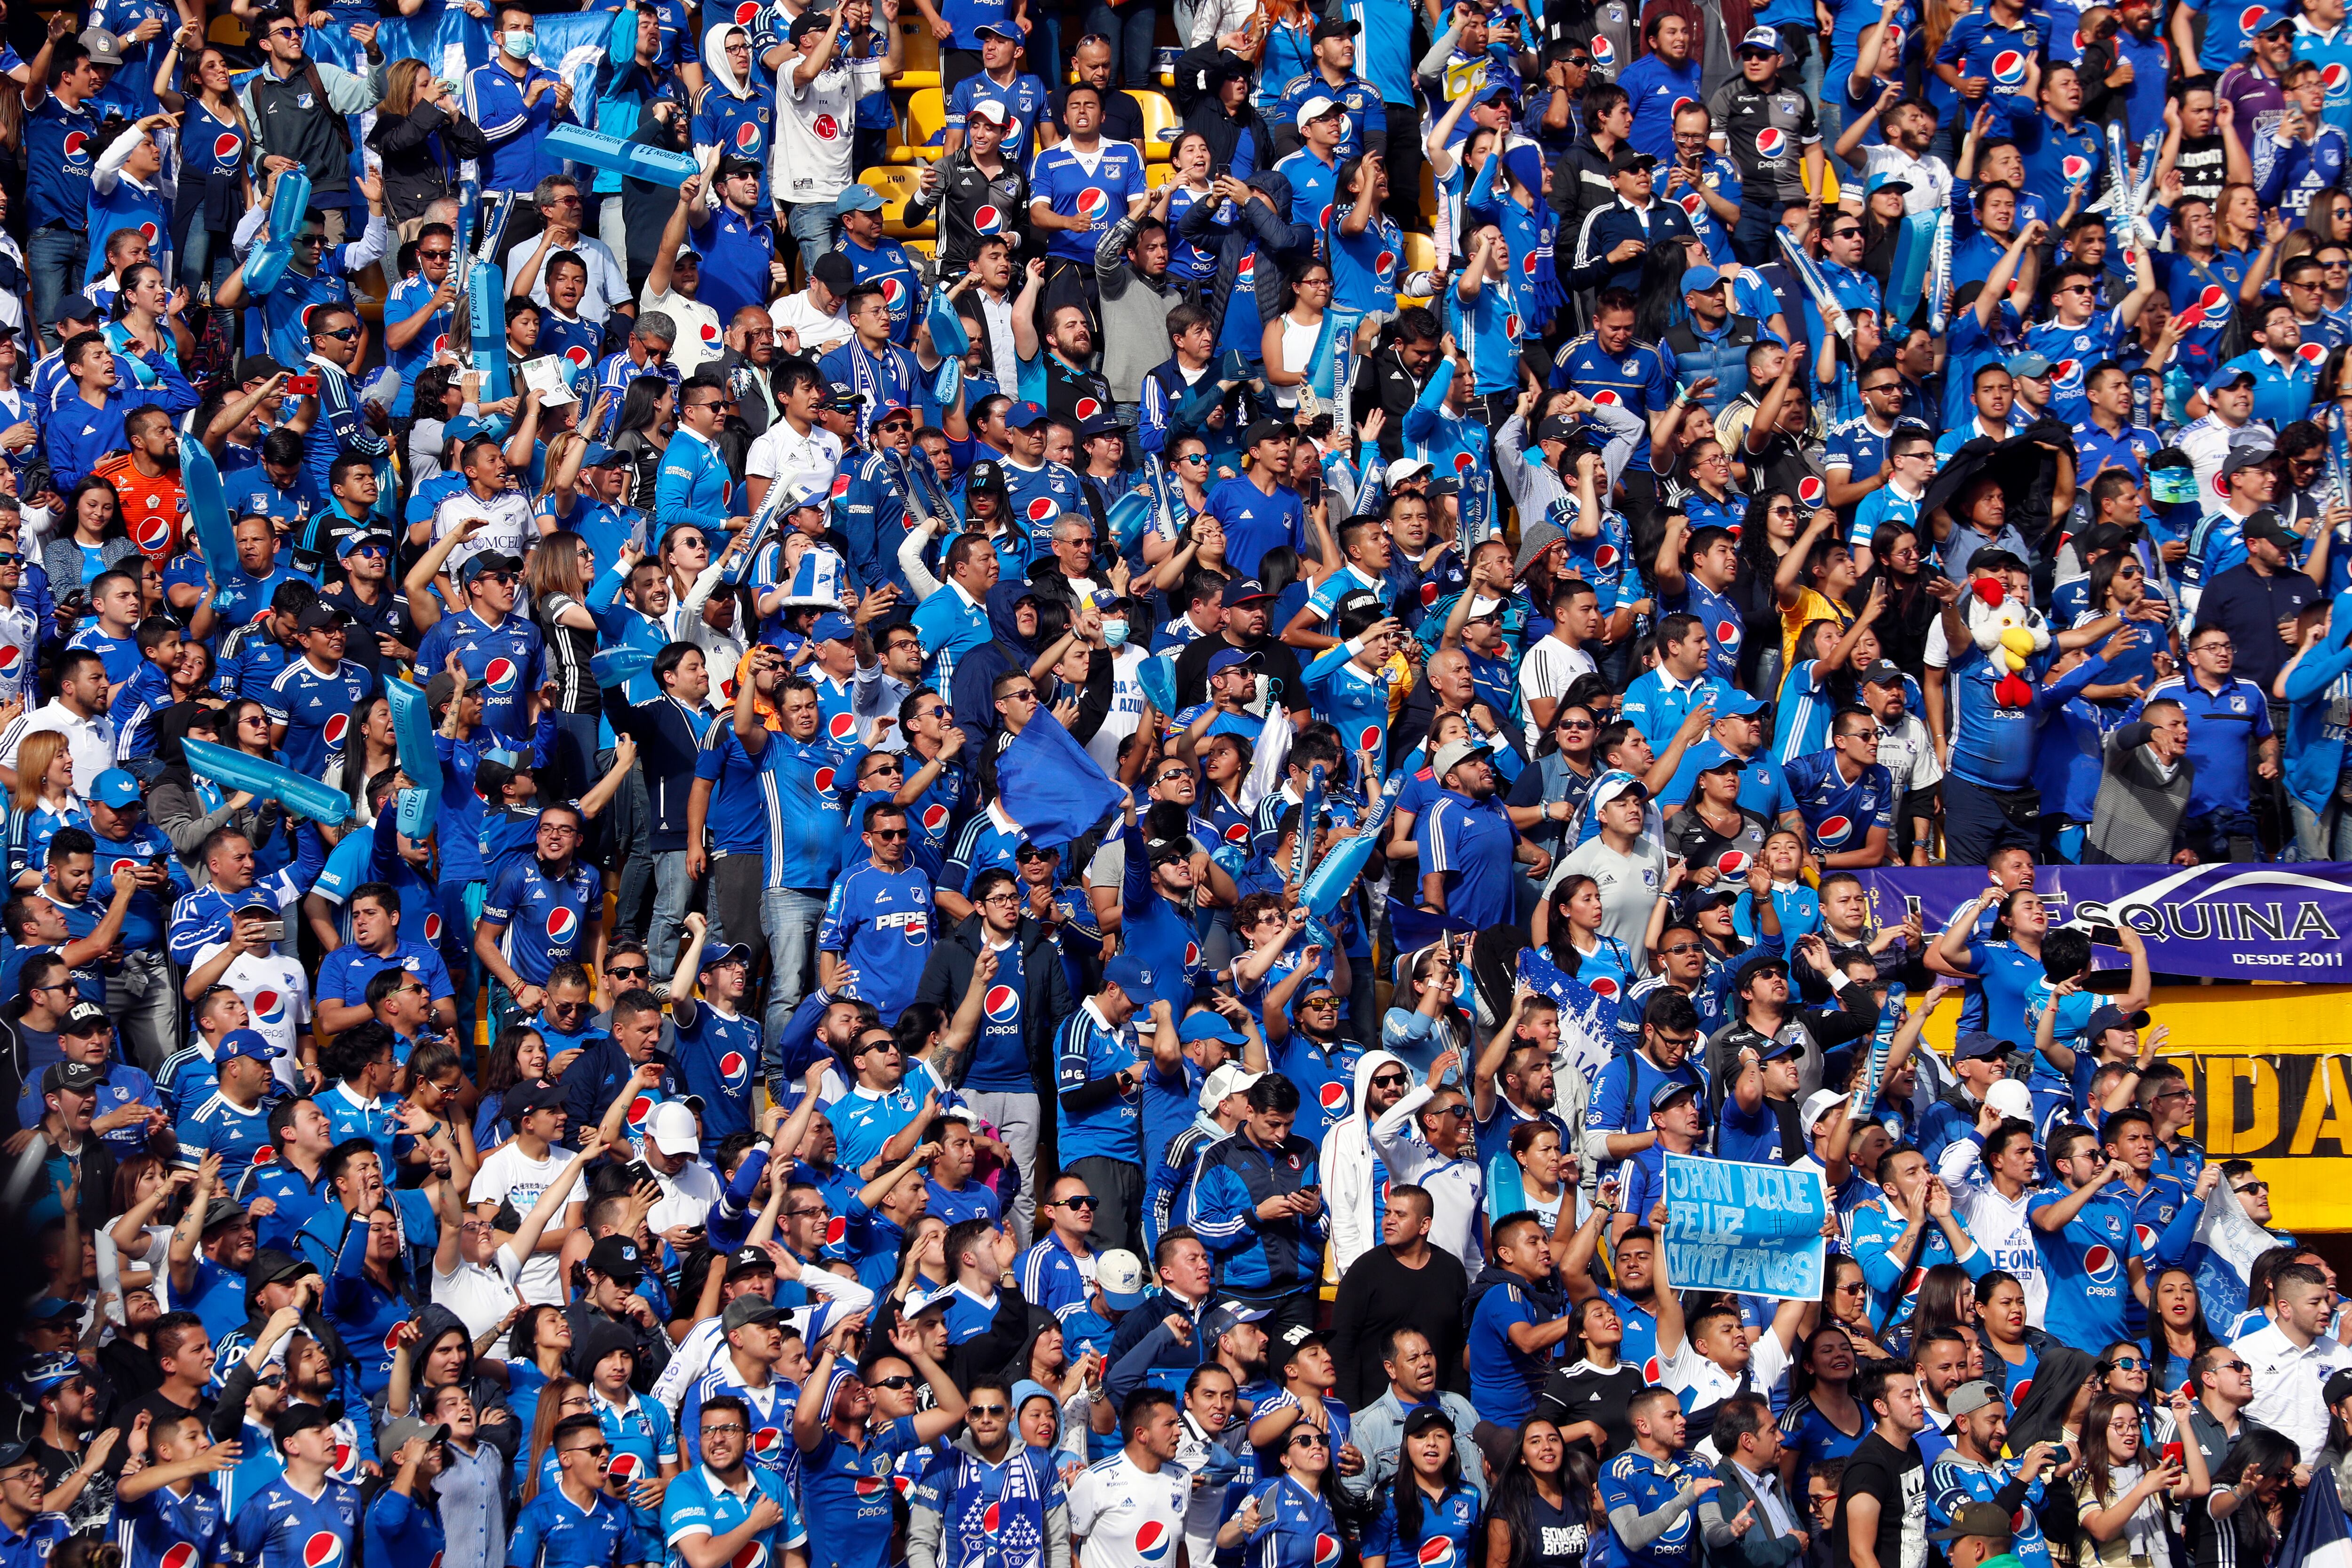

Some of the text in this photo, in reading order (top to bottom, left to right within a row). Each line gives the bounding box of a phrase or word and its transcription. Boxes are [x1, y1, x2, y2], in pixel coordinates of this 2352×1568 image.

[756, 39, 766, 48] LG
[564, 126, 595, 138] FUERON
[595, 134, 624, 145] NUNCA
[638, 145, 685, 162] FUERON 11
[1333, 145, 1350, 154] epsi
[1049, 159, 1076, 168] HYUNDAI
[1757, 159, 1786, 169] pepsi
[63, 166, 89, 177] pepsi
[1089, 221, 1108, 232] epsi
[890, 311, 907, 322] epsi
[2055, 389, 2086, 401] pepsi
[335, 428, 349, 436] LG
[1348, 594, 1377, 611] CAMPEONES
[488, 696, 513, 706] pepsi
[393, 698, 405, 734] RIVALO
[1994, 710, 2025, 719] pepsi
[1878, 758, 1908, 767] ERVEZA
[403, 788, 417, 817] VALO
[1316, 844, 1342, 874] FUERON
[322, 871, 342, 881] BALIFE
[875, 912, 929, 931] PEPS
[547, 947, 572, 958] pepsi
[2233, 953, 2343, 967] DESDE 2011
[985, 1025, 1017, 1036] pepsi
[1061, 1069, 1085, 1080] LG G2
[1668, 1159, 1733, 1204] JHON
[1666, 1201, 1745, 1246] FELIZ
[1769, 1215, 1814, 1238] #22
[2087, 1286, 2116, 1297] pepsi
[963, 1326, 983, 1336] adidas
[858, 1507, 888, 1519] pepsi
[1946, 1502, 1958, 1518] LG
[1654, 1544, 1686, 1556] pepsi
[2018, 1541, 2044, 1557] pepsi
